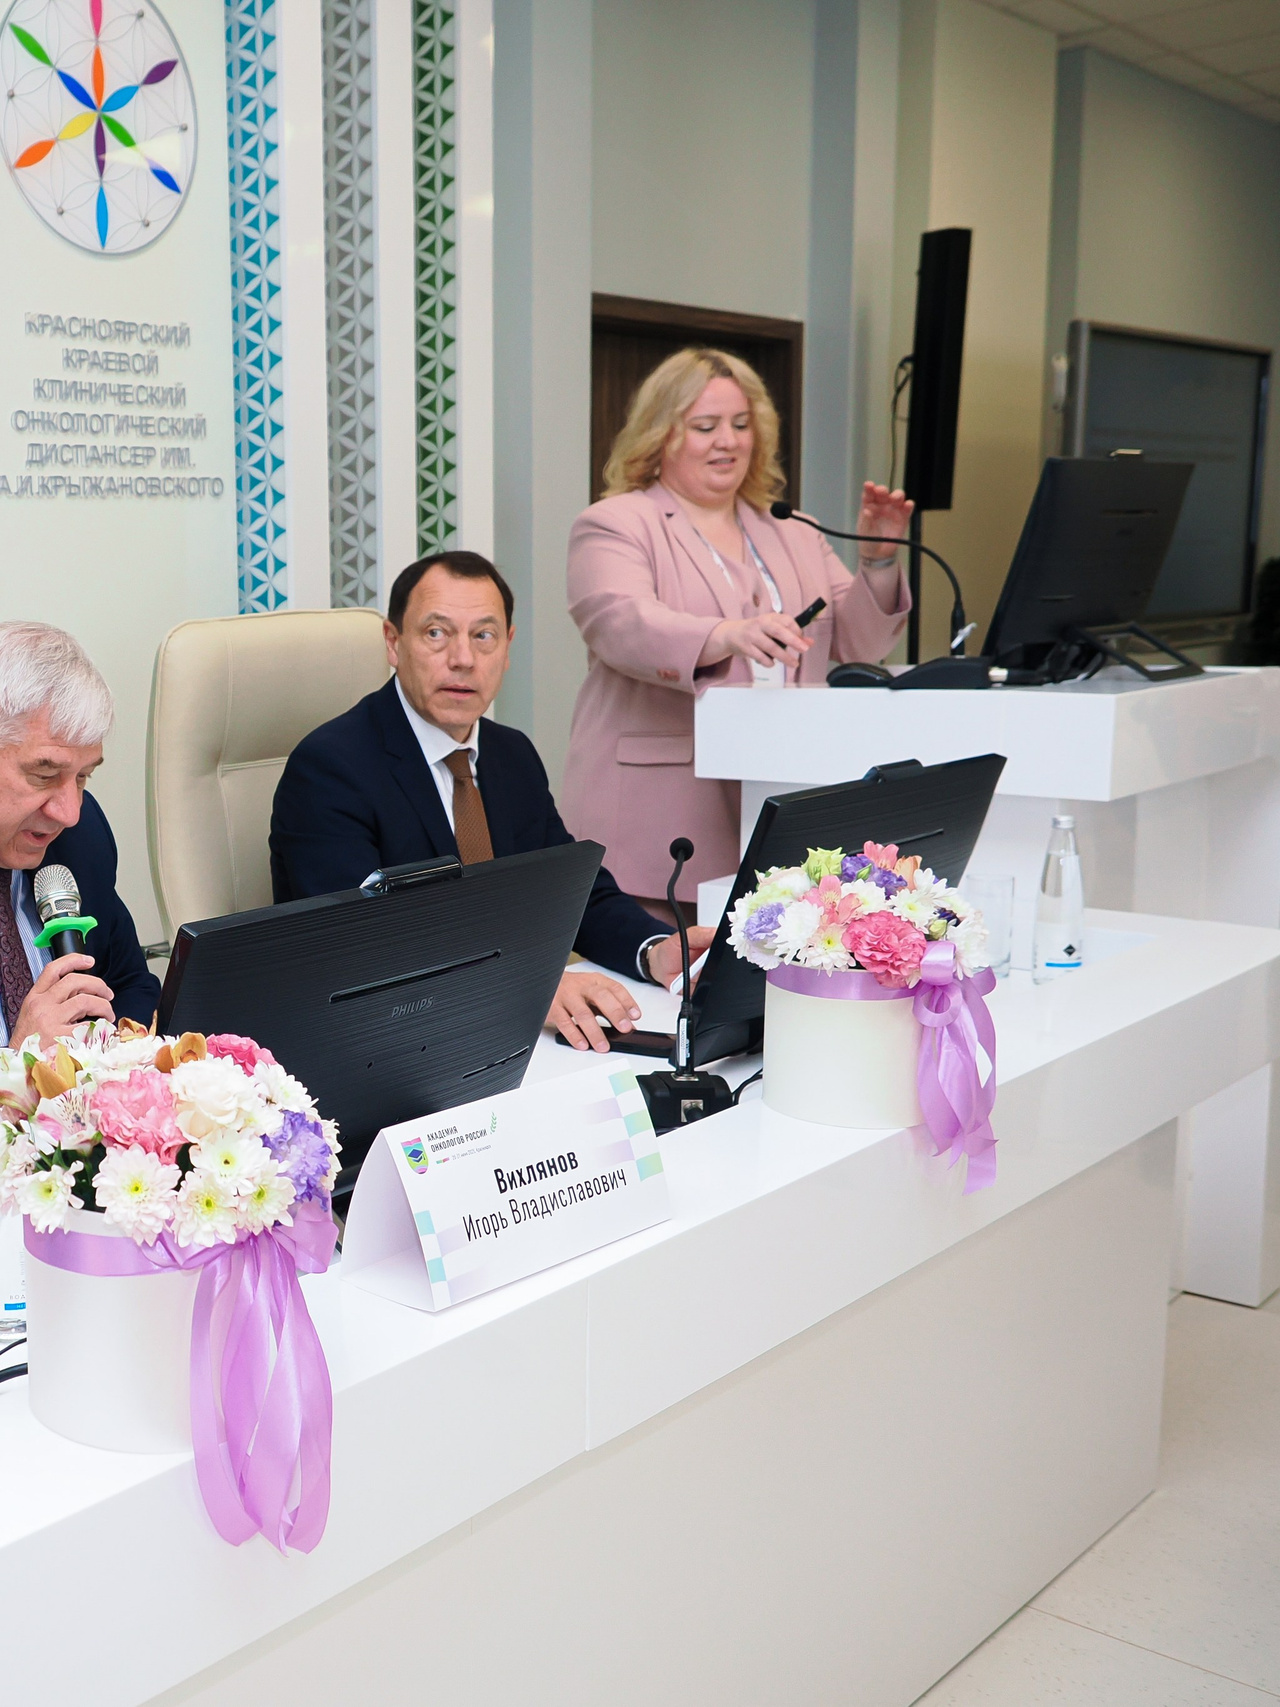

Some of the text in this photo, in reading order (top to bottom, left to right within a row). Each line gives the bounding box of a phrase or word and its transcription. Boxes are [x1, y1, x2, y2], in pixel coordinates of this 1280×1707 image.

[24, 311, 191, 348] КРАСНОЯРСКИЙ
[61, 347, 159, 376] КРАЕВОЙ
[32, 377, 187, 408] КЛИНИЧЕСКИЙ
[10, 409, 207, 439] ОНКОЛОГИЧЕСКИЙ
[25, 443, 197, 469] ДИСПАНСЕР ИМ.
[391, 996, 435, 1018] PHILIPS
[427, 1125, 459, 1142] АКАДЕМИЯ
[430, 1128, 488, 1153] ОНКОЛОГОВ РОССИИ
[494, 1150, 579, 1194] Вихлянов
[462, 1168, 628, 1242] Игорь Владиславович
